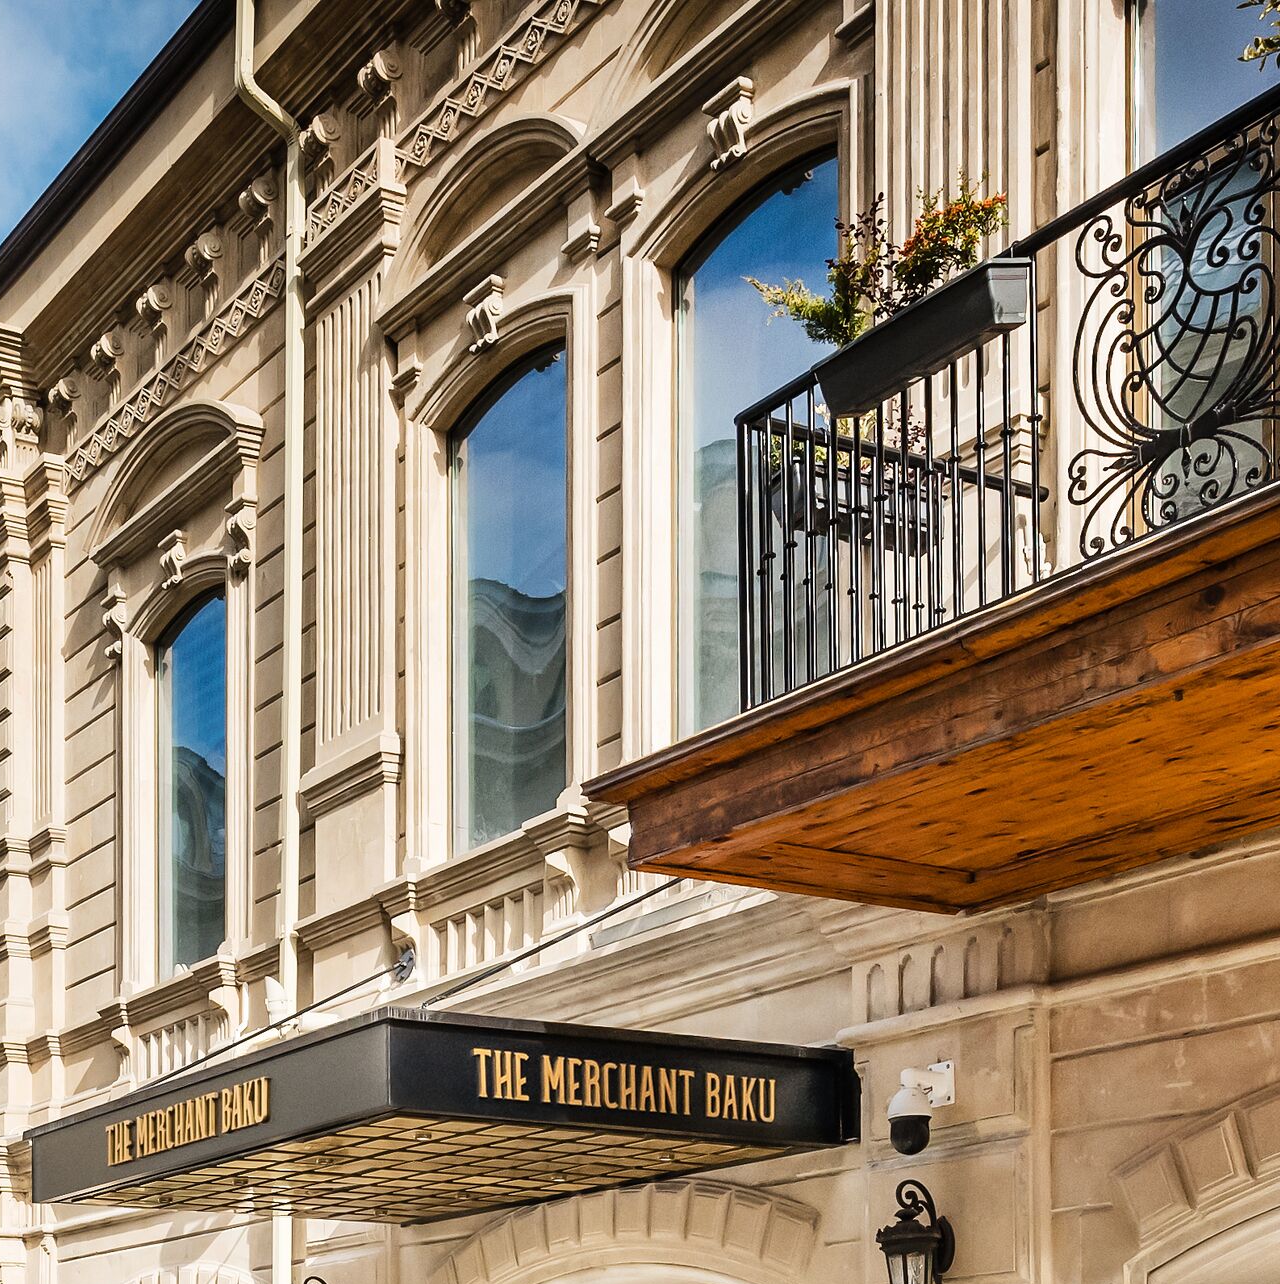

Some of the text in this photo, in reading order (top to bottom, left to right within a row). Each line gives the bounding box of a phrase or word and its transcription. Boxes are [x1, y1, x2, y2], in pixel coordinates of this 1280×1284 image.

[105, 1076, 271, 1167] THE MERCHANT BAKU
[472, 1047, 776, 1123] THE MERCHANT BAKU
